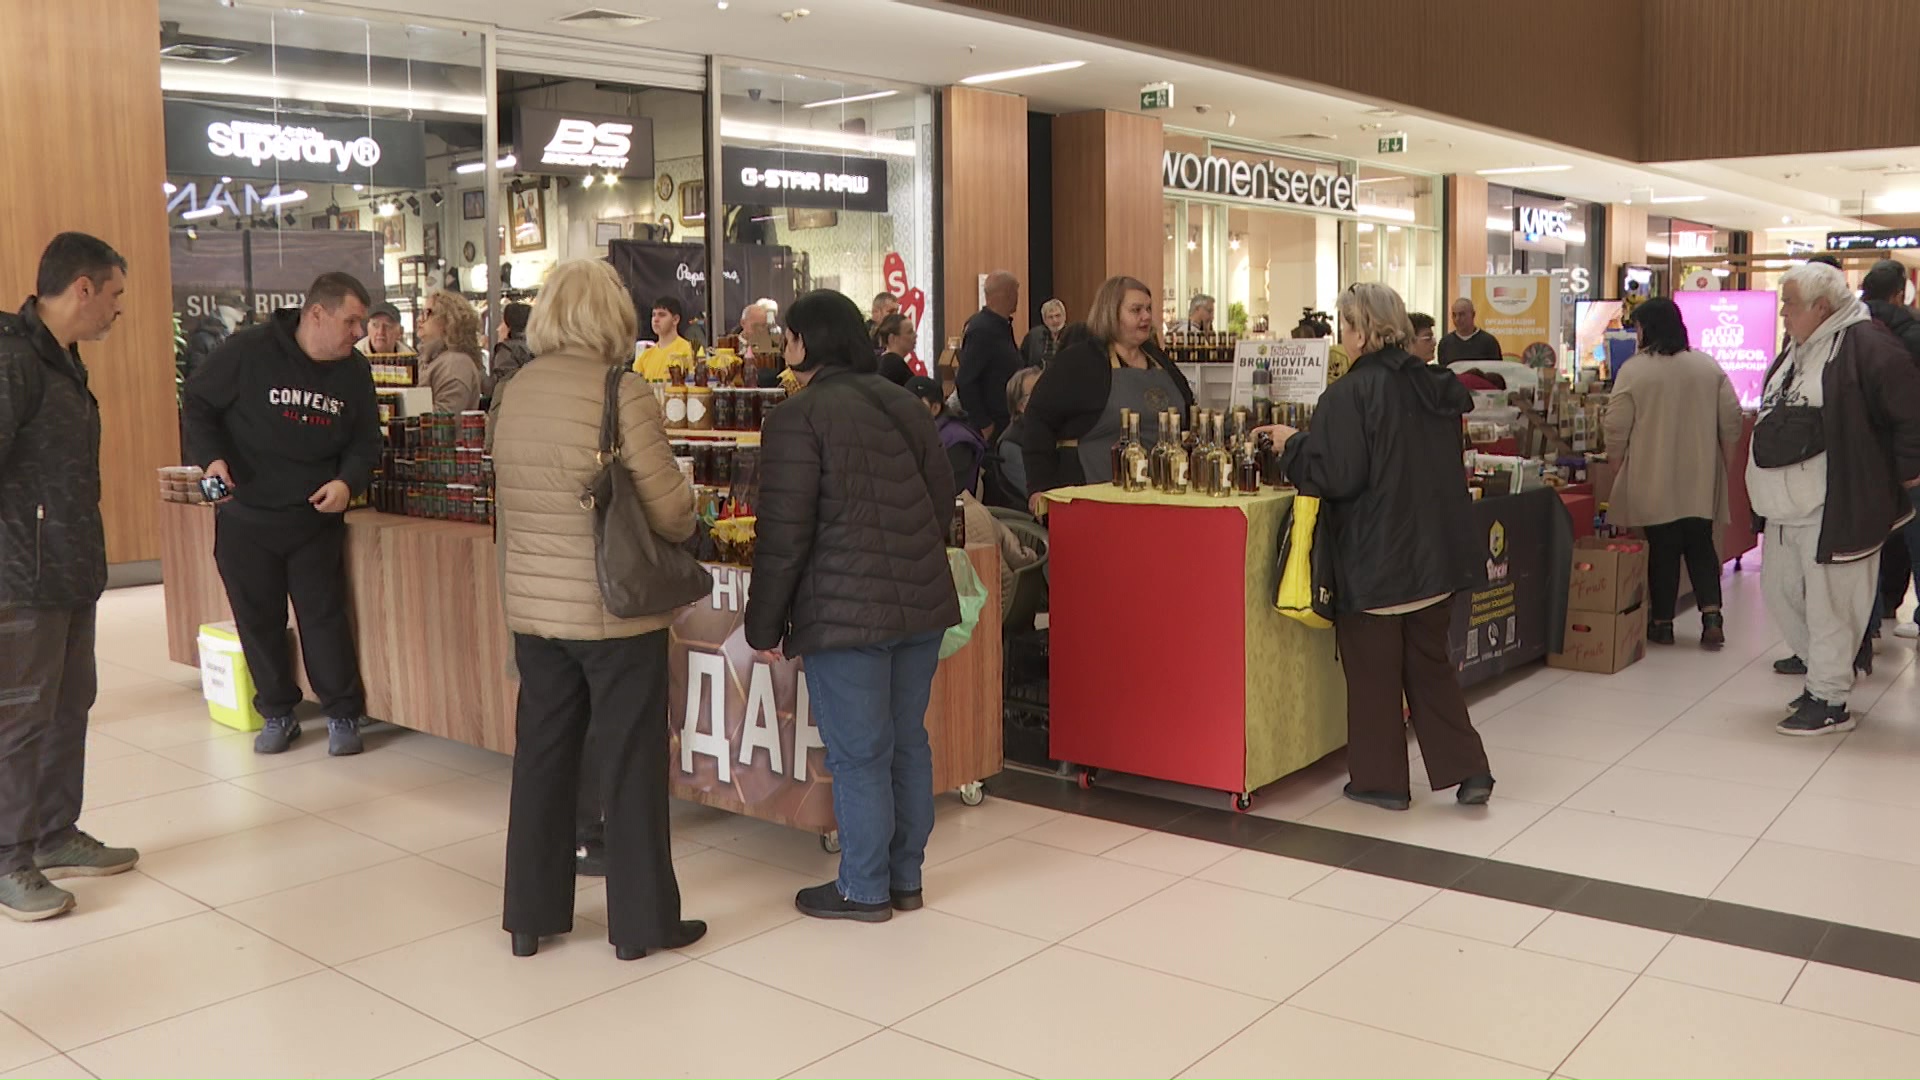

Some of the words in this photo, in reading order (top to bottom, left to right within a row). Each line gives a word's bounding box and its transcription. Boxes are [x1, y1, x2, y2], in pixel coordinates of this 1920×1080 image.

[544, 118, 633, 157] BS
[824, 173, 869, 194] RAW
[269, 387, 344, 415] CONVERS
